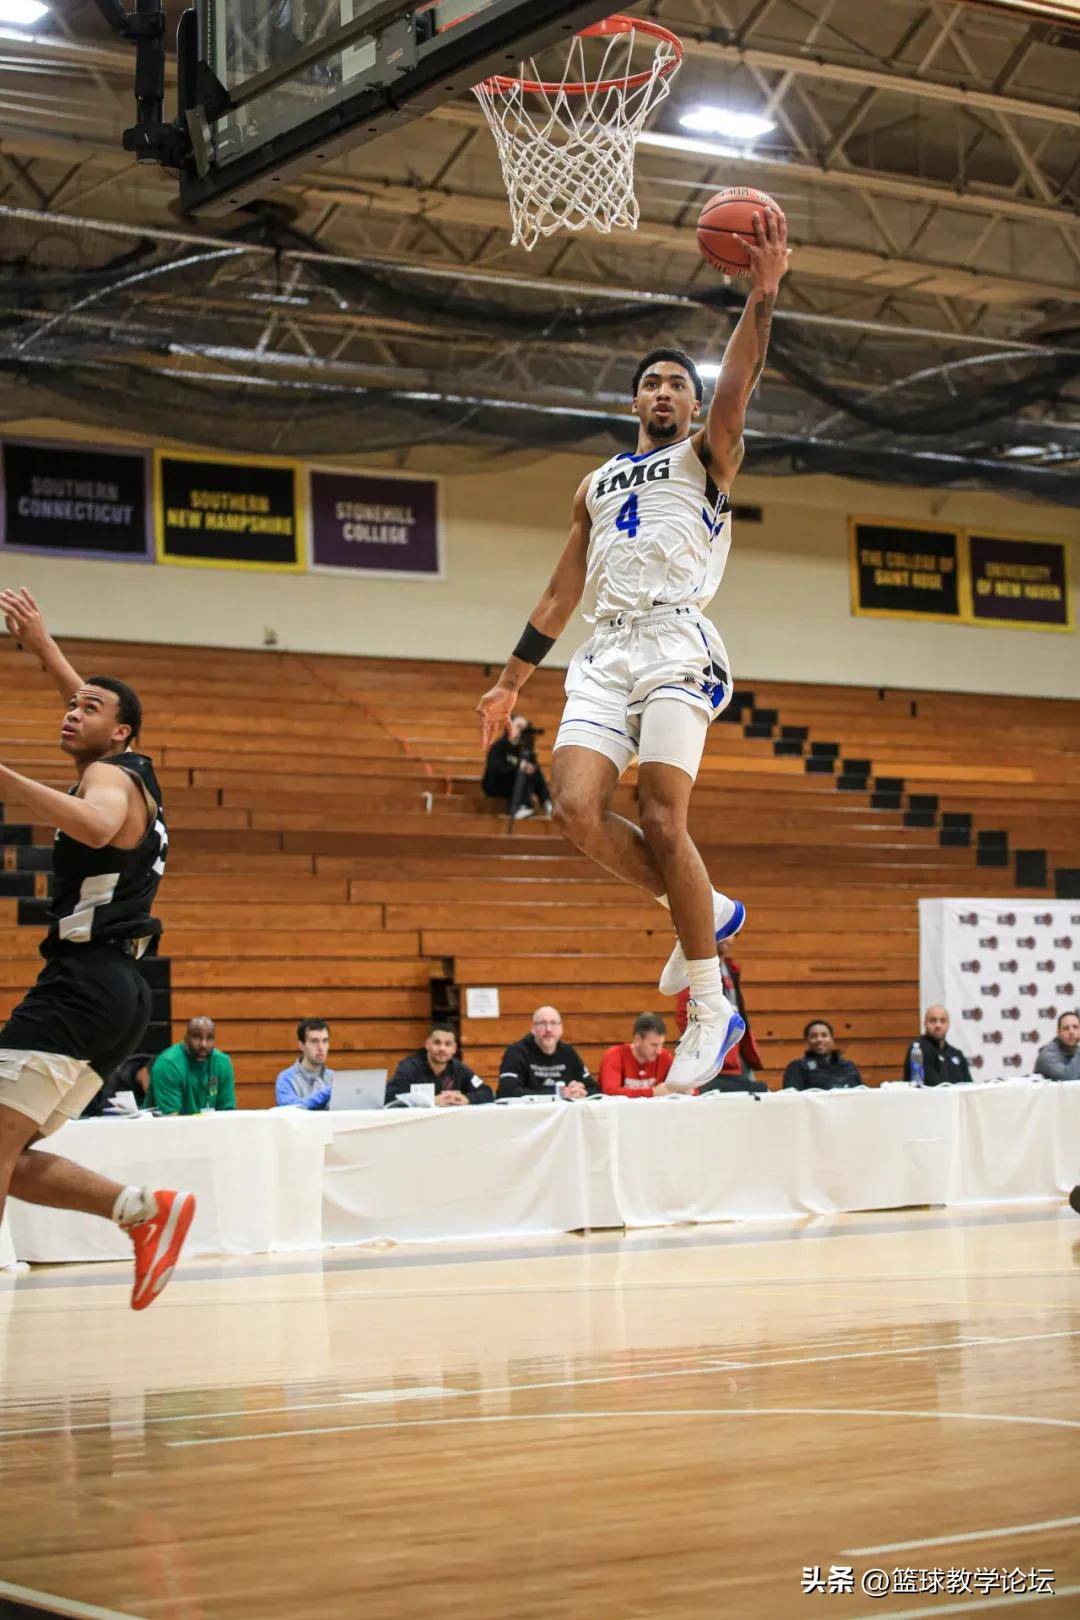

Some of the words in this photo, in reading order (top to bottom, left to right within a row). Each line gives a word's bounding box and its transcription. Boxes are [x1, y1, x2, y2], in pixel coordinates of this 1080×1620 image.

[31, 476, 119, 501] SOUTHERN
[595, 457, 671, 500] IMG
[17, 497, 135, 525] CONNECTICUT
[189, 489, 271, 512] SOUTHERN
[335, 501, 416, 525] STONEHILL
[167, 508, 202, 530] NEW
[204, 512, 293, 536] HAMPSHIRE
[615, 492, 641, 538] 4
[341, 522, 410, 545] COLLEGE
